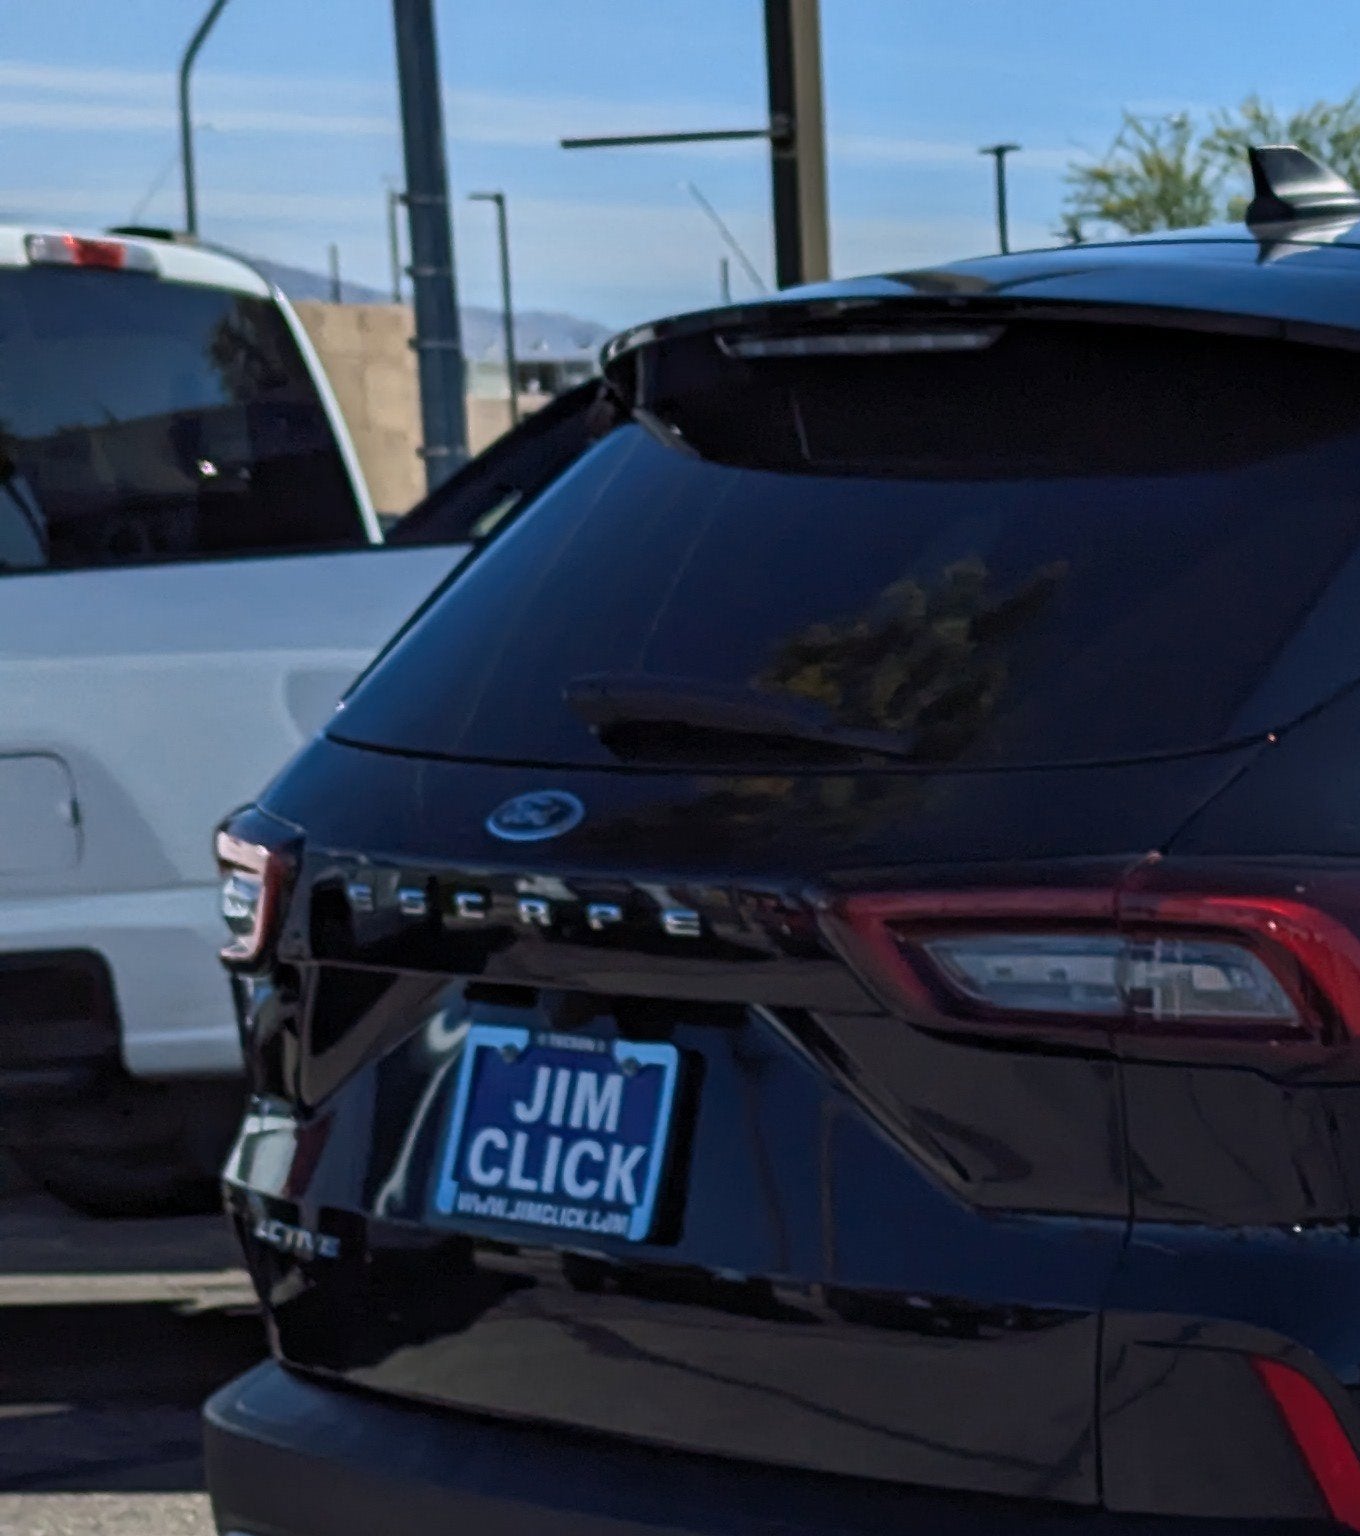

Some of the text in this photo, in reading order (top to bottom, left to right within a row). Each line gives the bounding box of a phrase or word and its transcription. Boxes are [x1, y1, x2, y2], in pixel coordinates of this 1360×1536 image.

[349, 883, 701, 937] ESCAPE
[514, 1066, 624, 1133] JIM
[468, 1127, 647, 1205] CLICK
